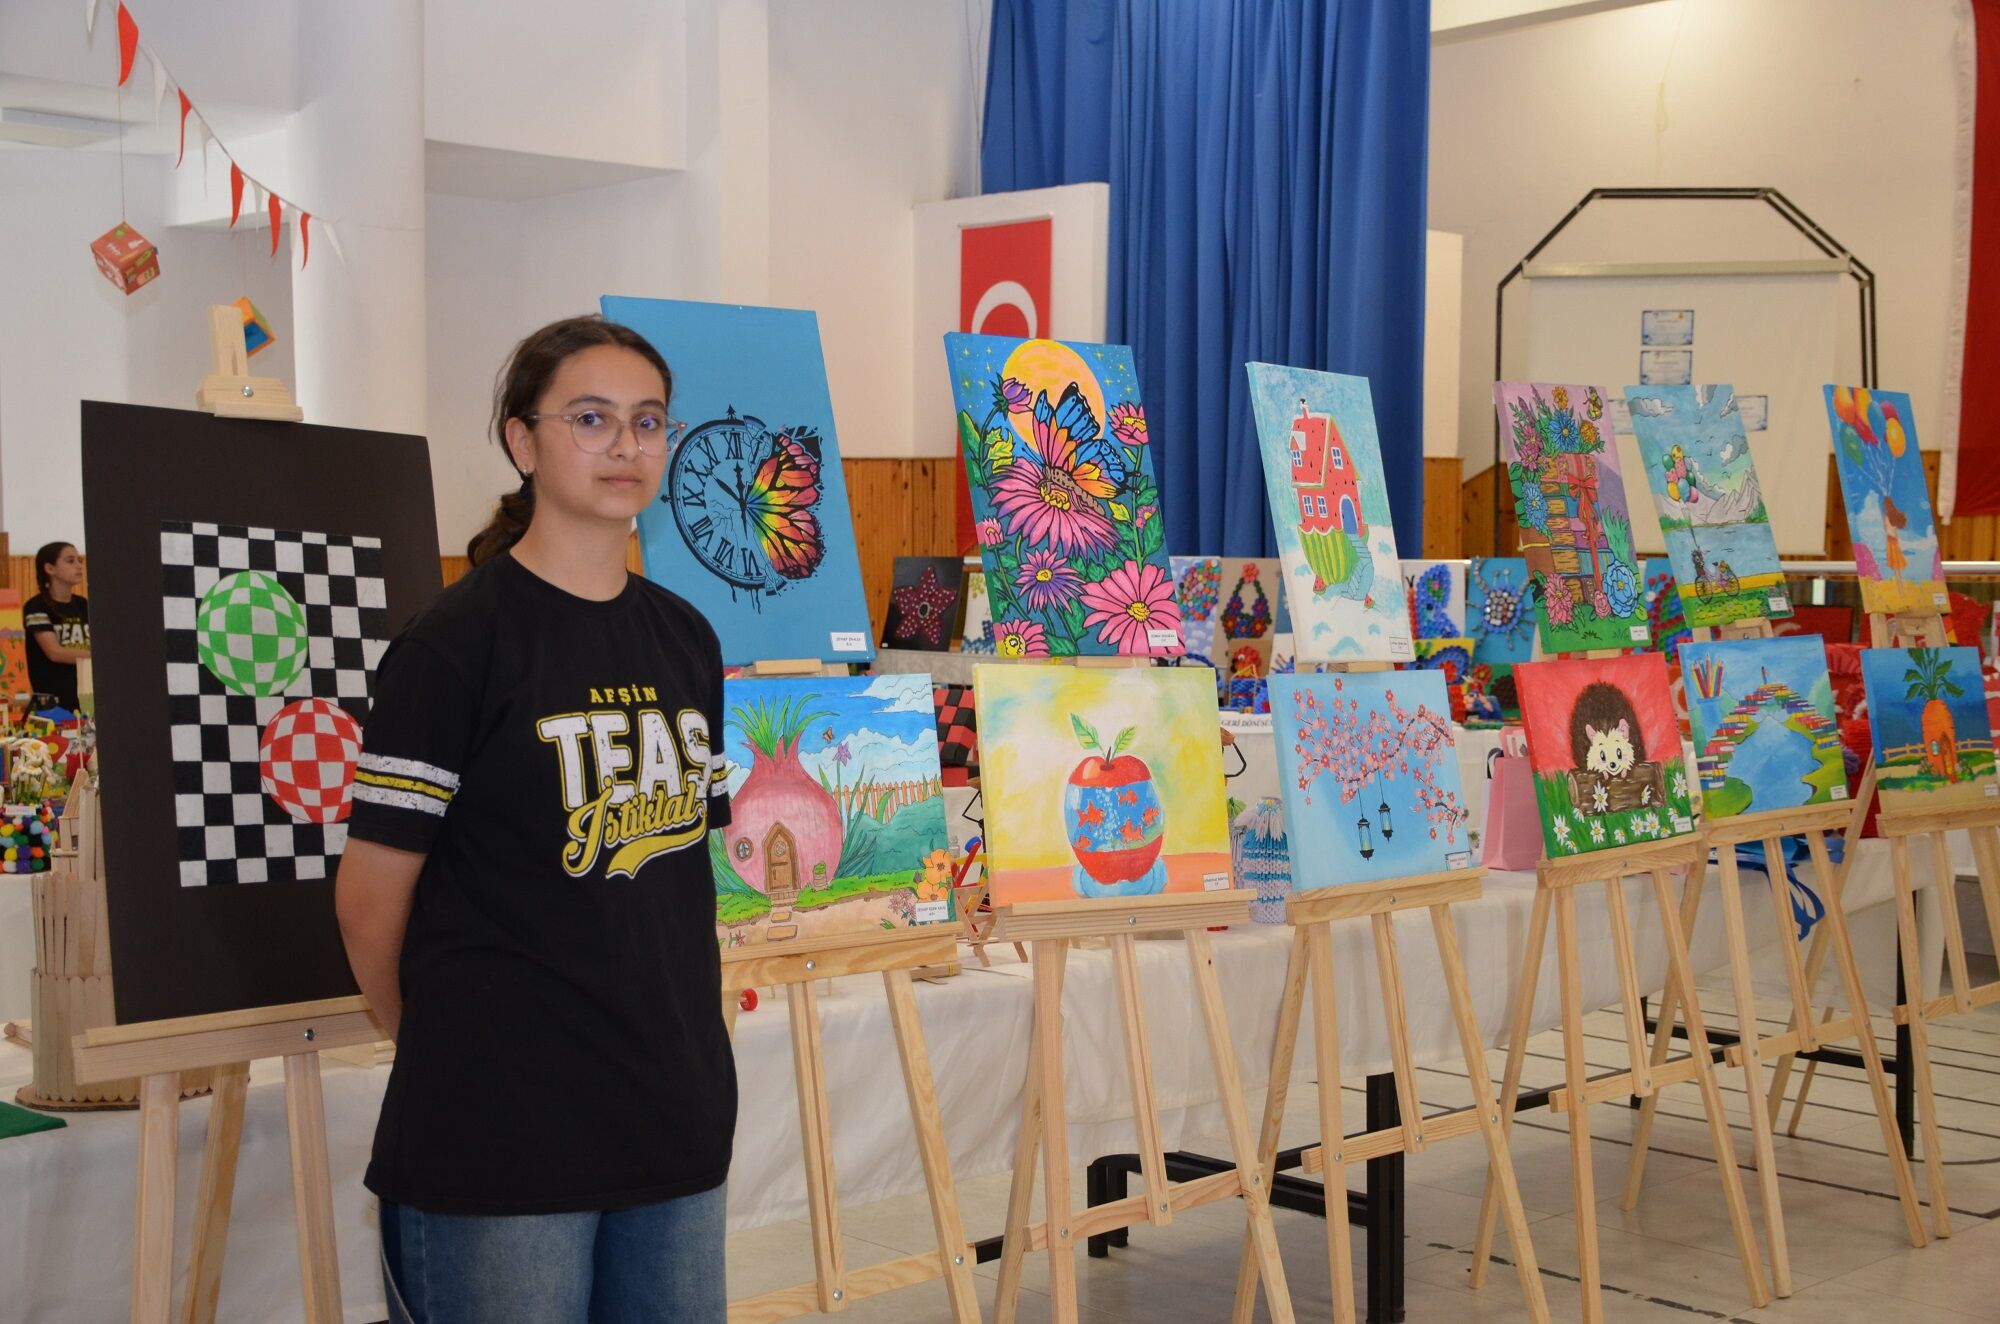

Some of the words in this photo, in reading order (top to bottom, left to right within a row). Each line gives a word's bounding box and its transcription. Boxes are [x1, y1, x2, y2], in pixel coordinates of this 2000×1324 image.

[720, 432, 745, 460] XII
[684, 459, 711, 488] X
[589, 683, 658, 707] AFŞİN
[536, 708, 712, 813] TEAS
